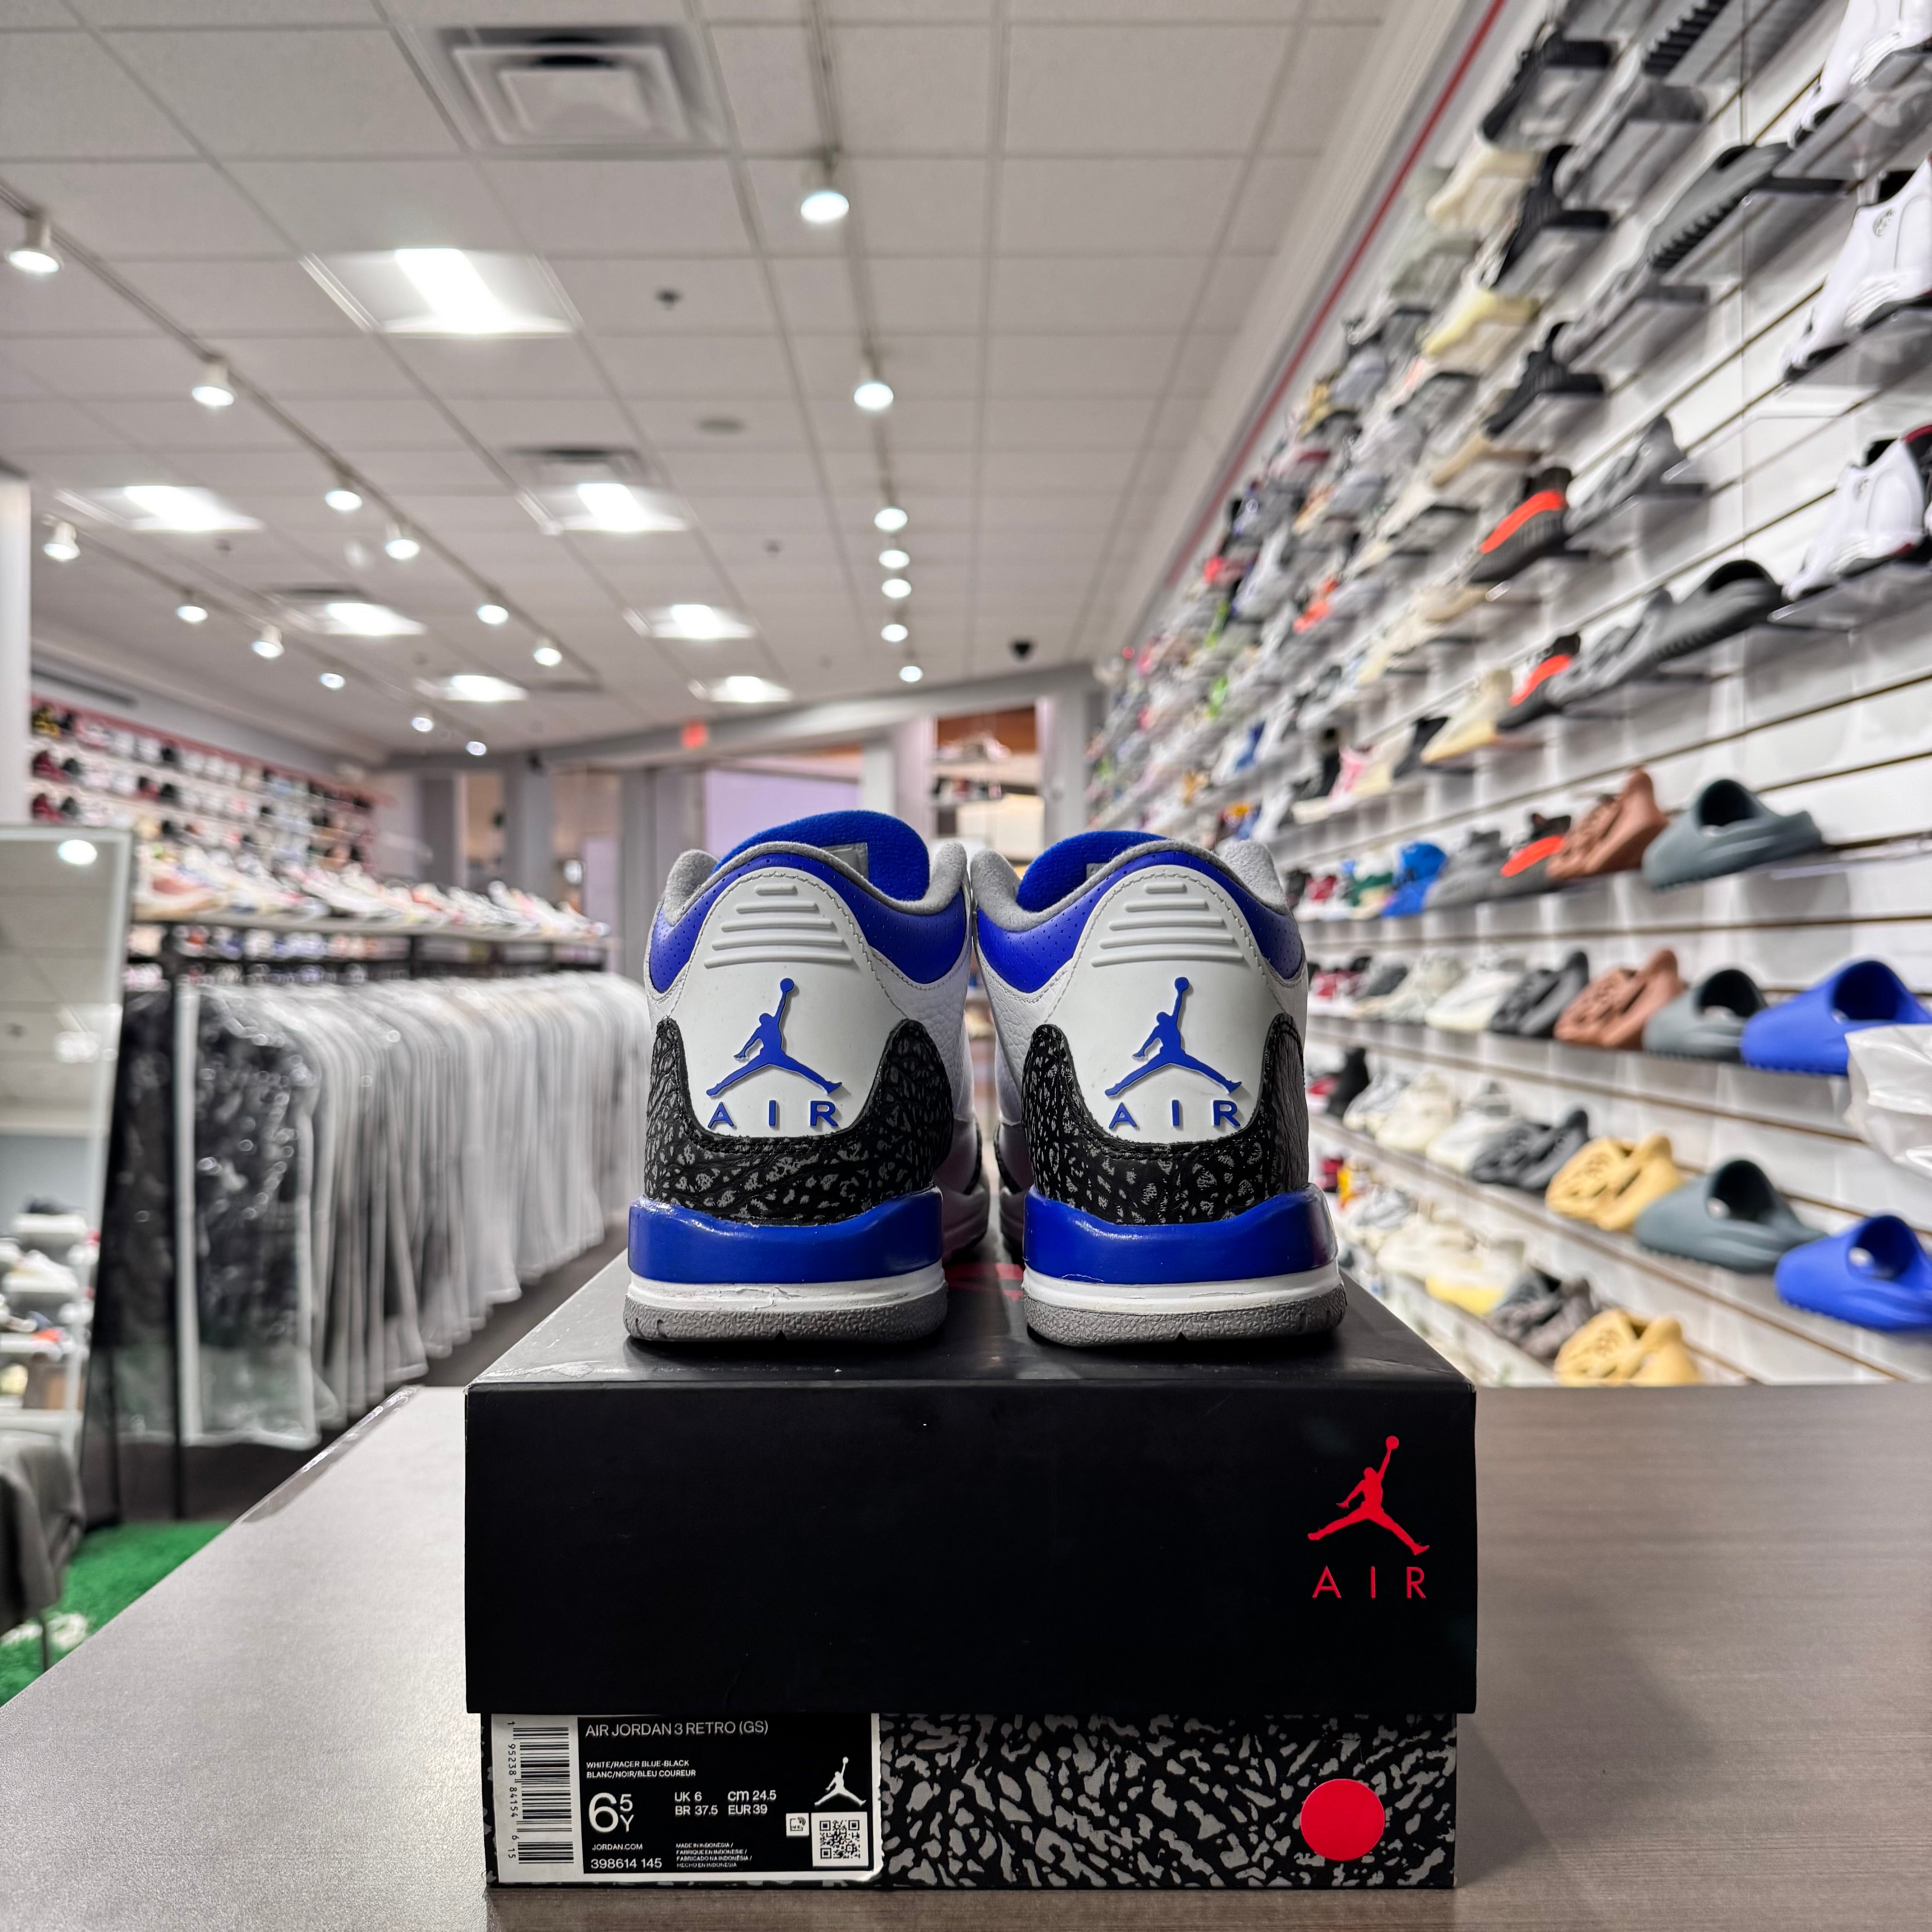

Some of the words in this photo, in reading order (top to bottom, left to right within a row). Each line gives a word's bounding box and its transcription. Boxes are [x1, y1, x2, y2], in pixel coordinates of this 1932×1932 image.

[708, 1100, 838, 1128] AIR
[1109, 1099, 1240, 1129] AIR
[1312, 1566, 1426, 1599] AIR
[586, 1725, 609, 1736] AIR
[612, 1723, 672, 1736] JORDAN
[675, 1723, 683, 1735] 3
[686, 1721, 736, 1735] RETRO
[739, 1720, 768, 1735] (GS)
[508, 1744, 516, 1775] 95238
[587, 1770, 657, 1779] BLANC/NOIR/BLEU
[510, 1787, 518, 1817] 84154
[675, 1792, 690, 1802] UK
[695, 1792, 702, 1801] 6
[727, 1791, 749, 1801] cm
[753, 1790, 776, 1801] 24.5
[675, 1805, 690, 1815] BR
[695, 1805, 718, 1815] 37.5
[728, 1805, 751, 1815] EUR
[753, 1804, 768, 1814] 39
[620, 1814, 634, 1832] Y
[508, 1849, 515, 1858] 15
[591, 1858, 637, 1868] 398614
[641, 1858, 662, 1868] 145
